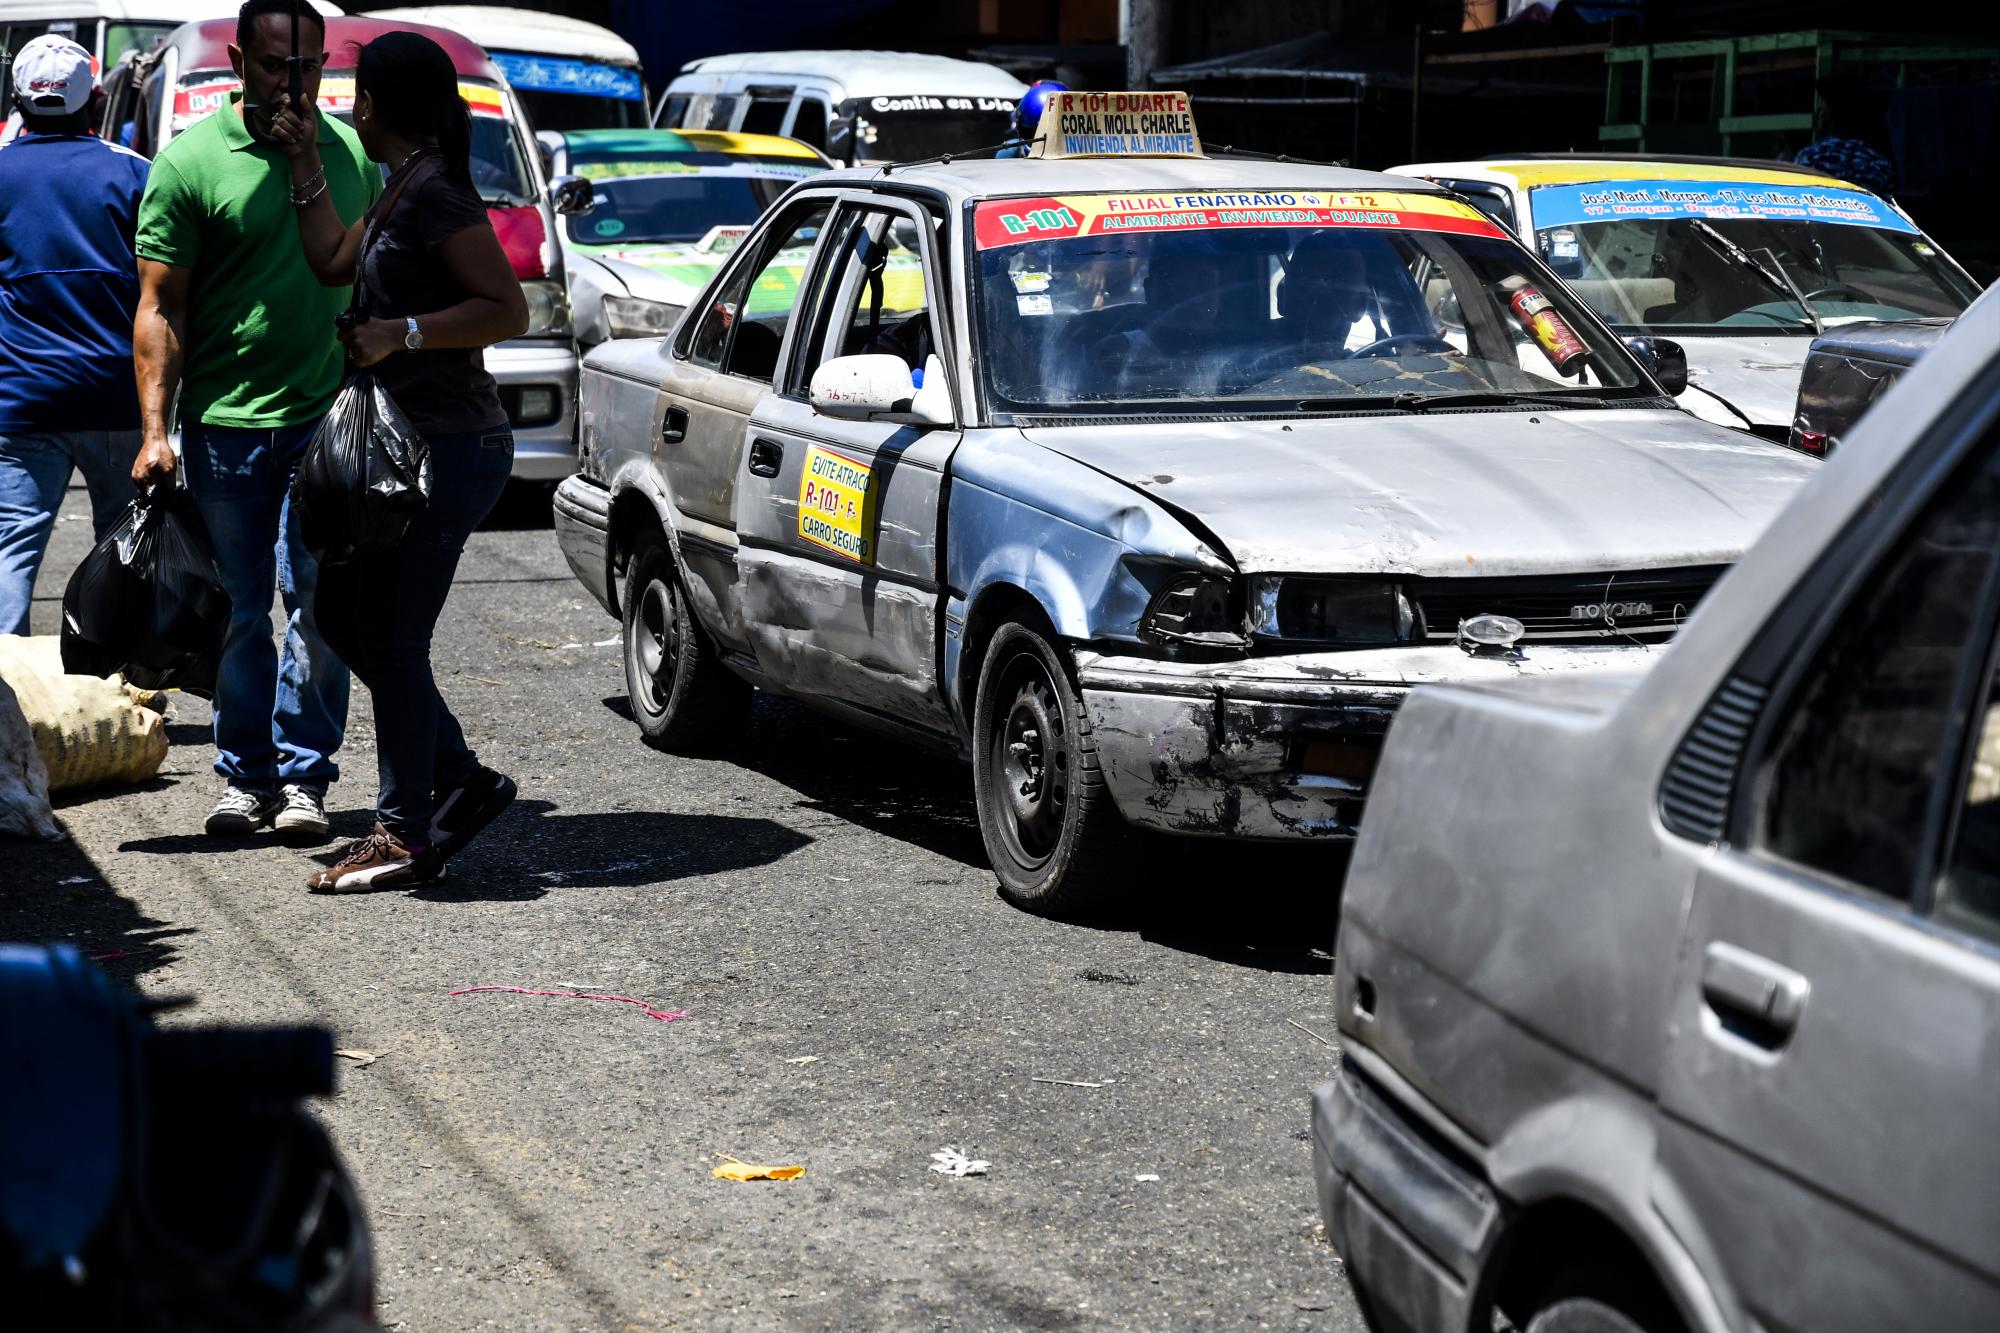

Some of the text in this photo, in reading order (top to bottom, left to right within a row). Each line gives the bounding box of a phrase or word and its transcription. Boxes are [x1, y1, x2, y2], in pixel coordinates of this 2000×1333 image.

[946, 97, 973, 110] en
[1063, 95, 1187, 112] R 101 DUARTE
[1061, 114, 1190, 135] CORAL MOLL CHARLE
[1065, 135, 1194, 153] INVIVIENDA ALMIRANTE
[1108, 197, 1171, 211] FILIAL
[1175, 194, 1296, 208] FENATRANO
[1582, 191, 1612, 205] José
[1613, 190, 1651, 204] Martí
[1659, 189, 1711, 205] Morgan
[1741, 191, 1767, 205] Los
[1103, 212, 1208, 230] ALMIRANTE
[1219, 210, 1321, 224] INVIVIENDA
[1332, 211, 1400, 225] DUARTE
[1613, 205, 1673, 217] Morgan
[1750, 205, 1807, 217] Parque
[1001, 208, 1076, 233] R-101
[836, 465, 871, 493] ATRACO
[805, 481, 839, 514] R-101
[802, 516, 868, 557] CARRO SEGURO
[1573, 602, 1652, 618] TOYOTA
